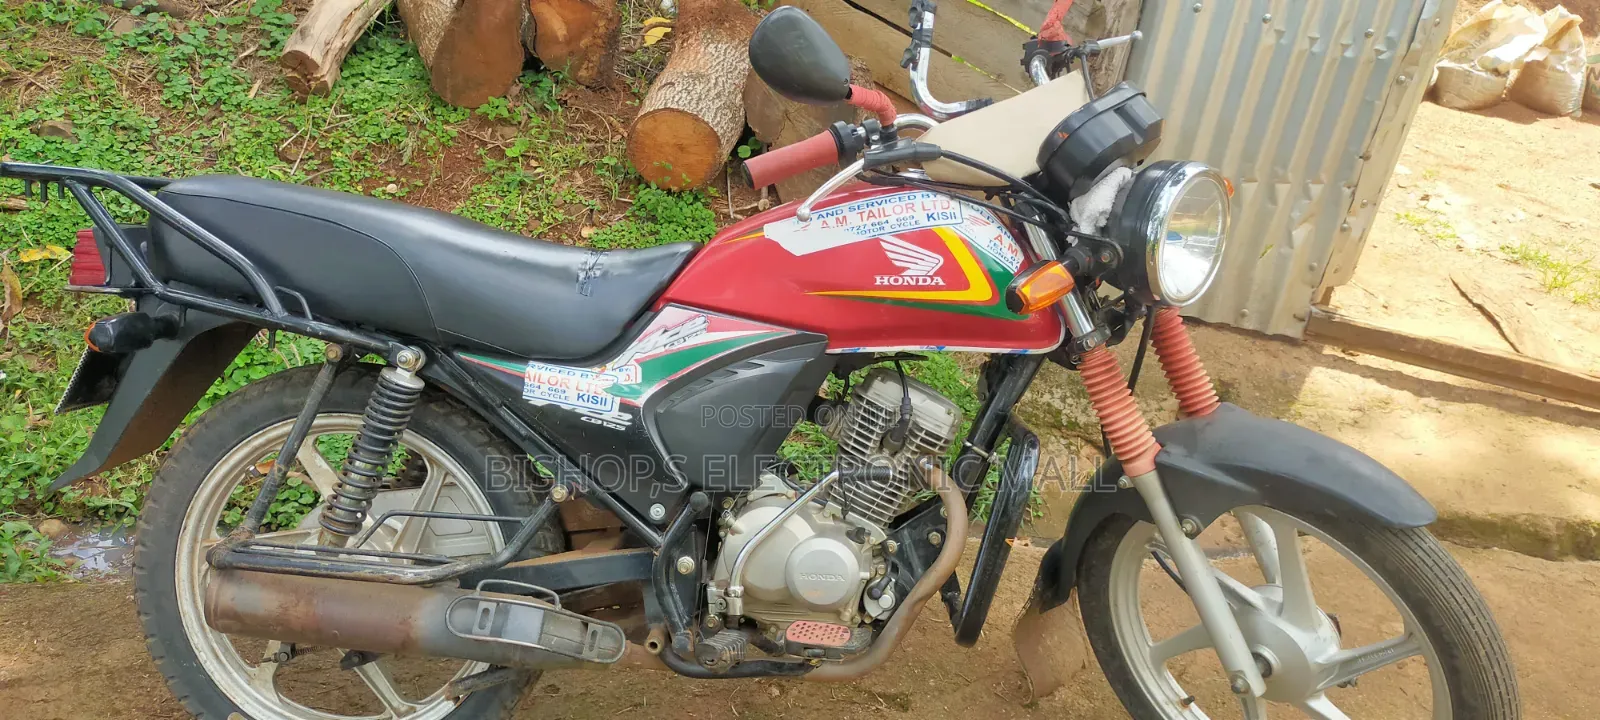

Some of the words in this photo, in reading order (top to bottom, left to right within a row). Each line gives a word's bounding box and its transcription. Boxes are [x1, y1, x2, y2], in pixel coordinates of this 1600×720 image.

[817, 208, 844, 220] AND
[848, 194, 917, 212] SERVICED
[856, 202, 917, 223] TAILOR
[921, 199, 956, 213] LTD.
[964, 202, 996, 224] OLD
[870, 219, 889, 228] 664
[896, 214, 915, 222] 669
[926, 211, 957, 222] KISII
[853, 226, 885, 237] OTOR
[890, 220, 921, 230] CYCLE
[874, 275, 946, 286] HONDA
[540, 391, 570, 401] CYCLE
[576, 392, 608, 407] KISII
[800, 573, 847, 582] HONDA
